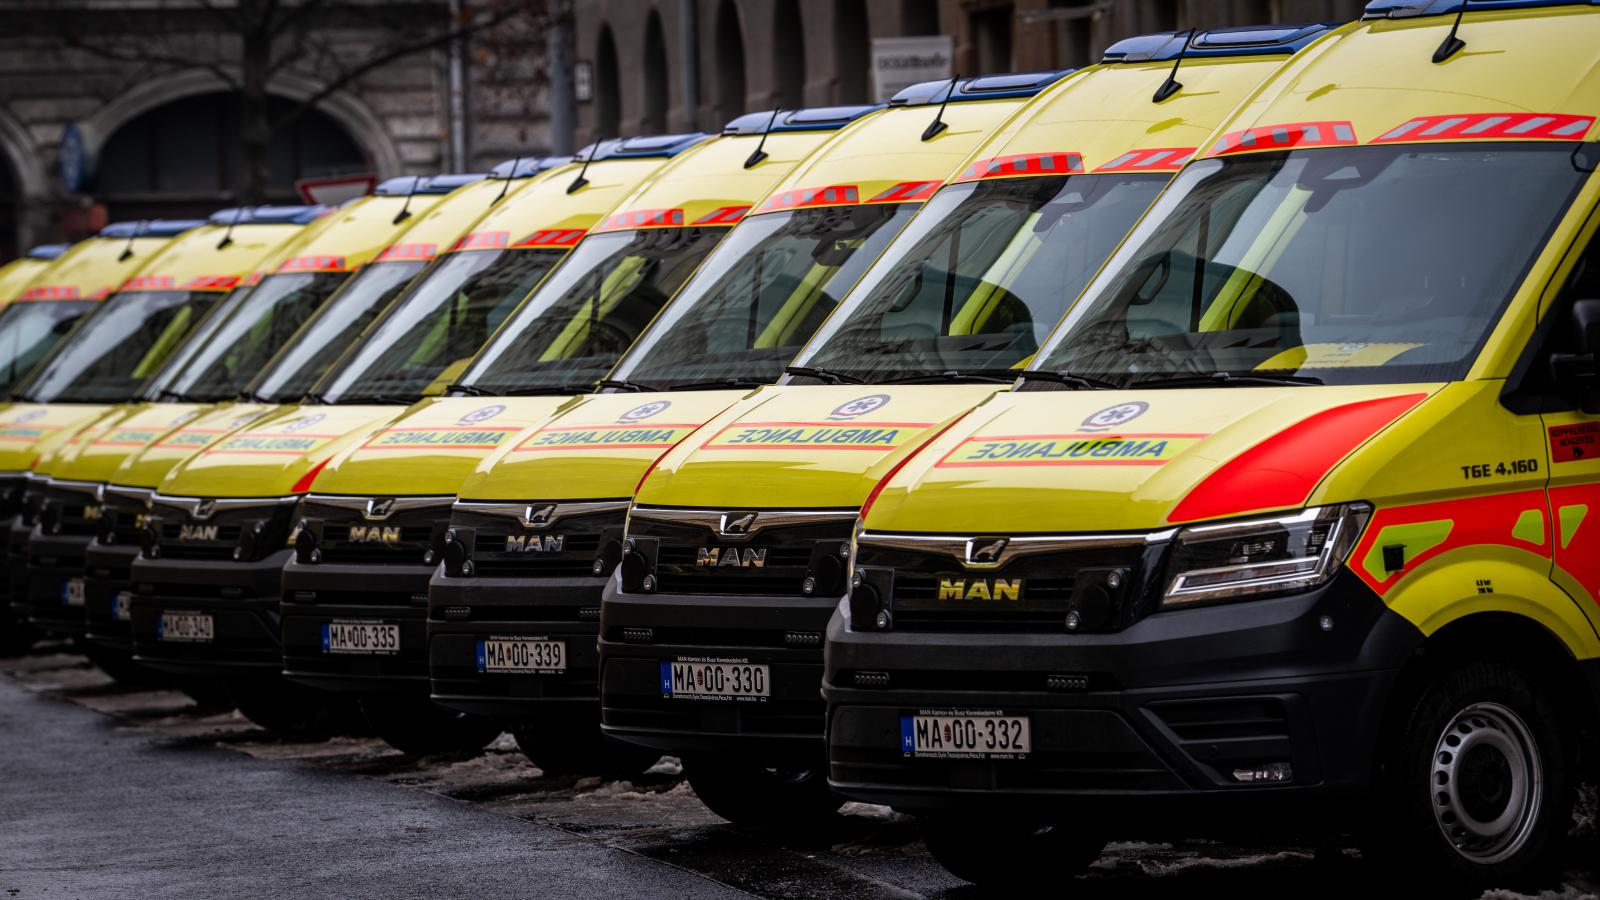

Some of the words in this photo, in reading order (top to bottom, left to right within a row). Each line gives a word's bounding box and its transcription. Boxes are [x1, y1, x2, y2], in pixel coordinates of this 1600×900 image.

[1461, 464, 1491, 480] TGE
[1494, 459, 1538, 477] 4.160
[349, 526, 400, 543] MAN
[505, 535, 564, 552] MAN
[696, 547, 767, 568] MAN
[938, 578, 1022, 601] MAN
[487, 643, 505, 666] MA
[674, 665, 696, 691] MA
[916, 719, 943, 749] MA
